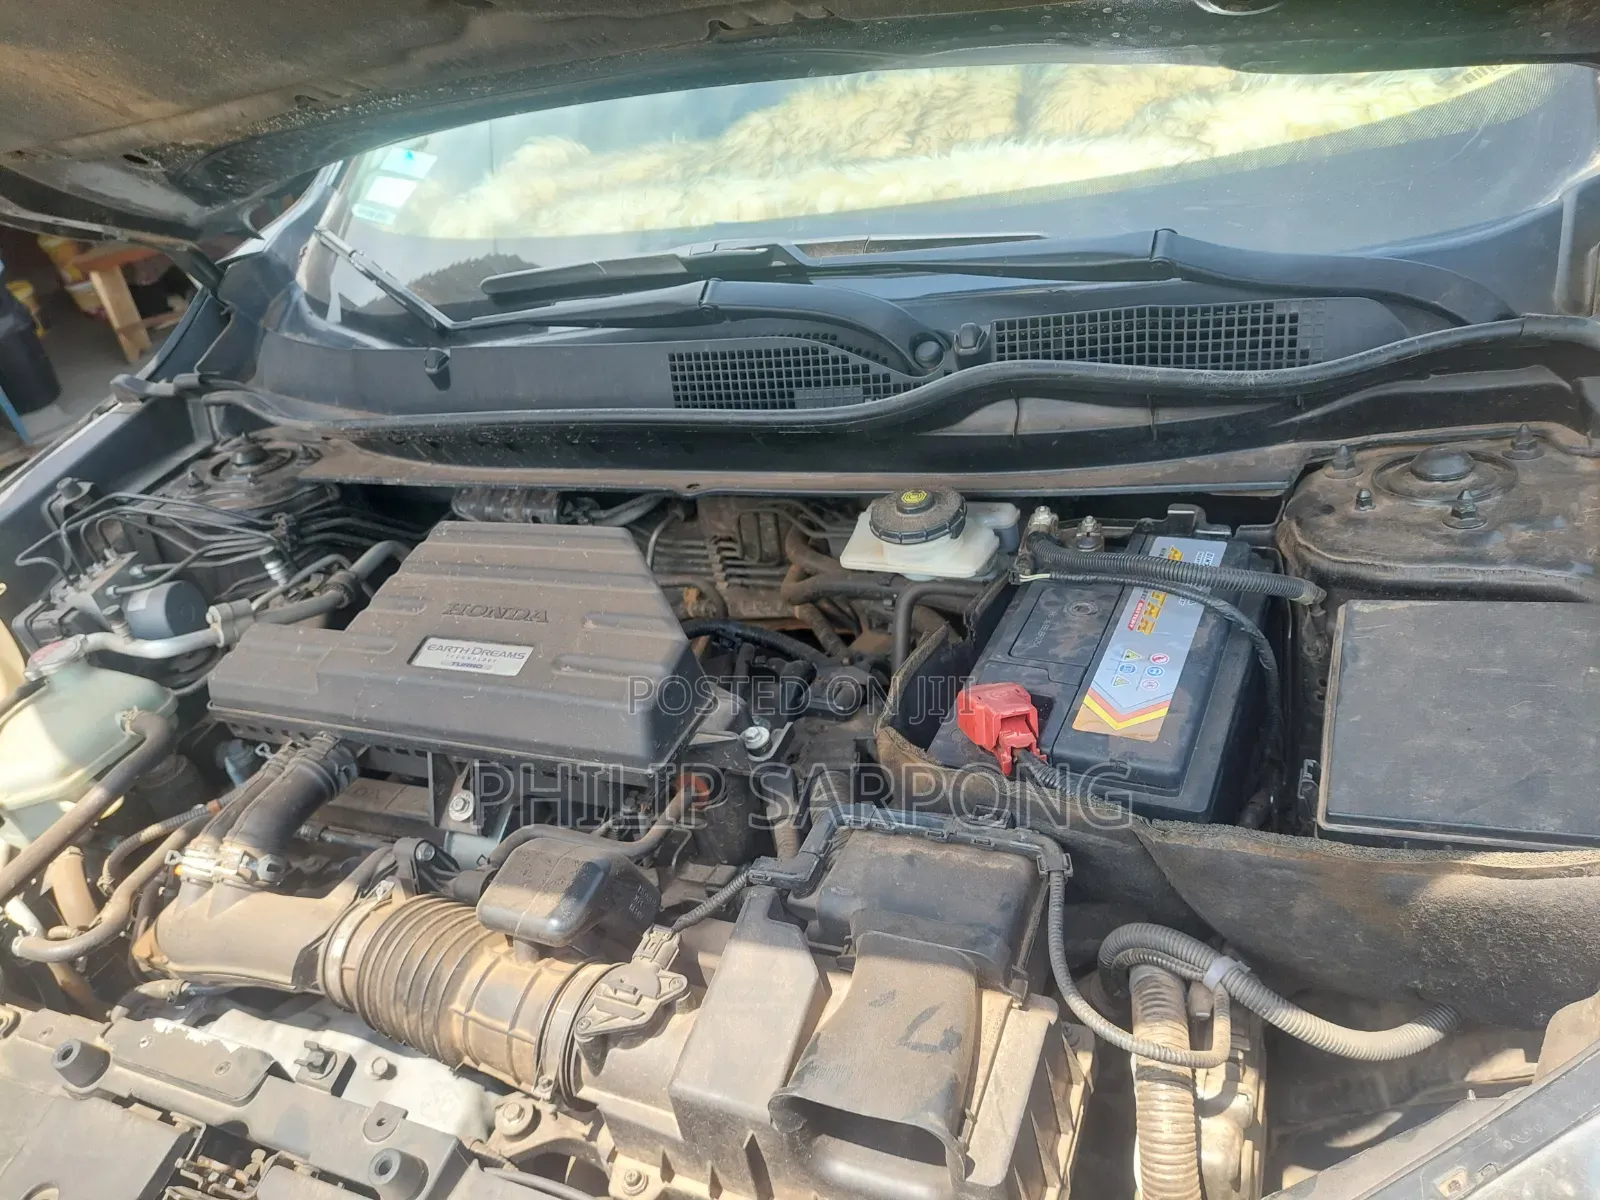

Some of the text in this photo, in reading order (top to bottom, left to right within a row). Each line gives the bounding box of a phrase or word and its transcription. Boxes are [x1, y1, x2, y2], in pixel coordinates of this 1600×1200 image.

[441, 603, 549, 623] HONDA
[427, 644, 526, 660] EARTH DREAMS
[451, 661, 483, 669] TURBO
